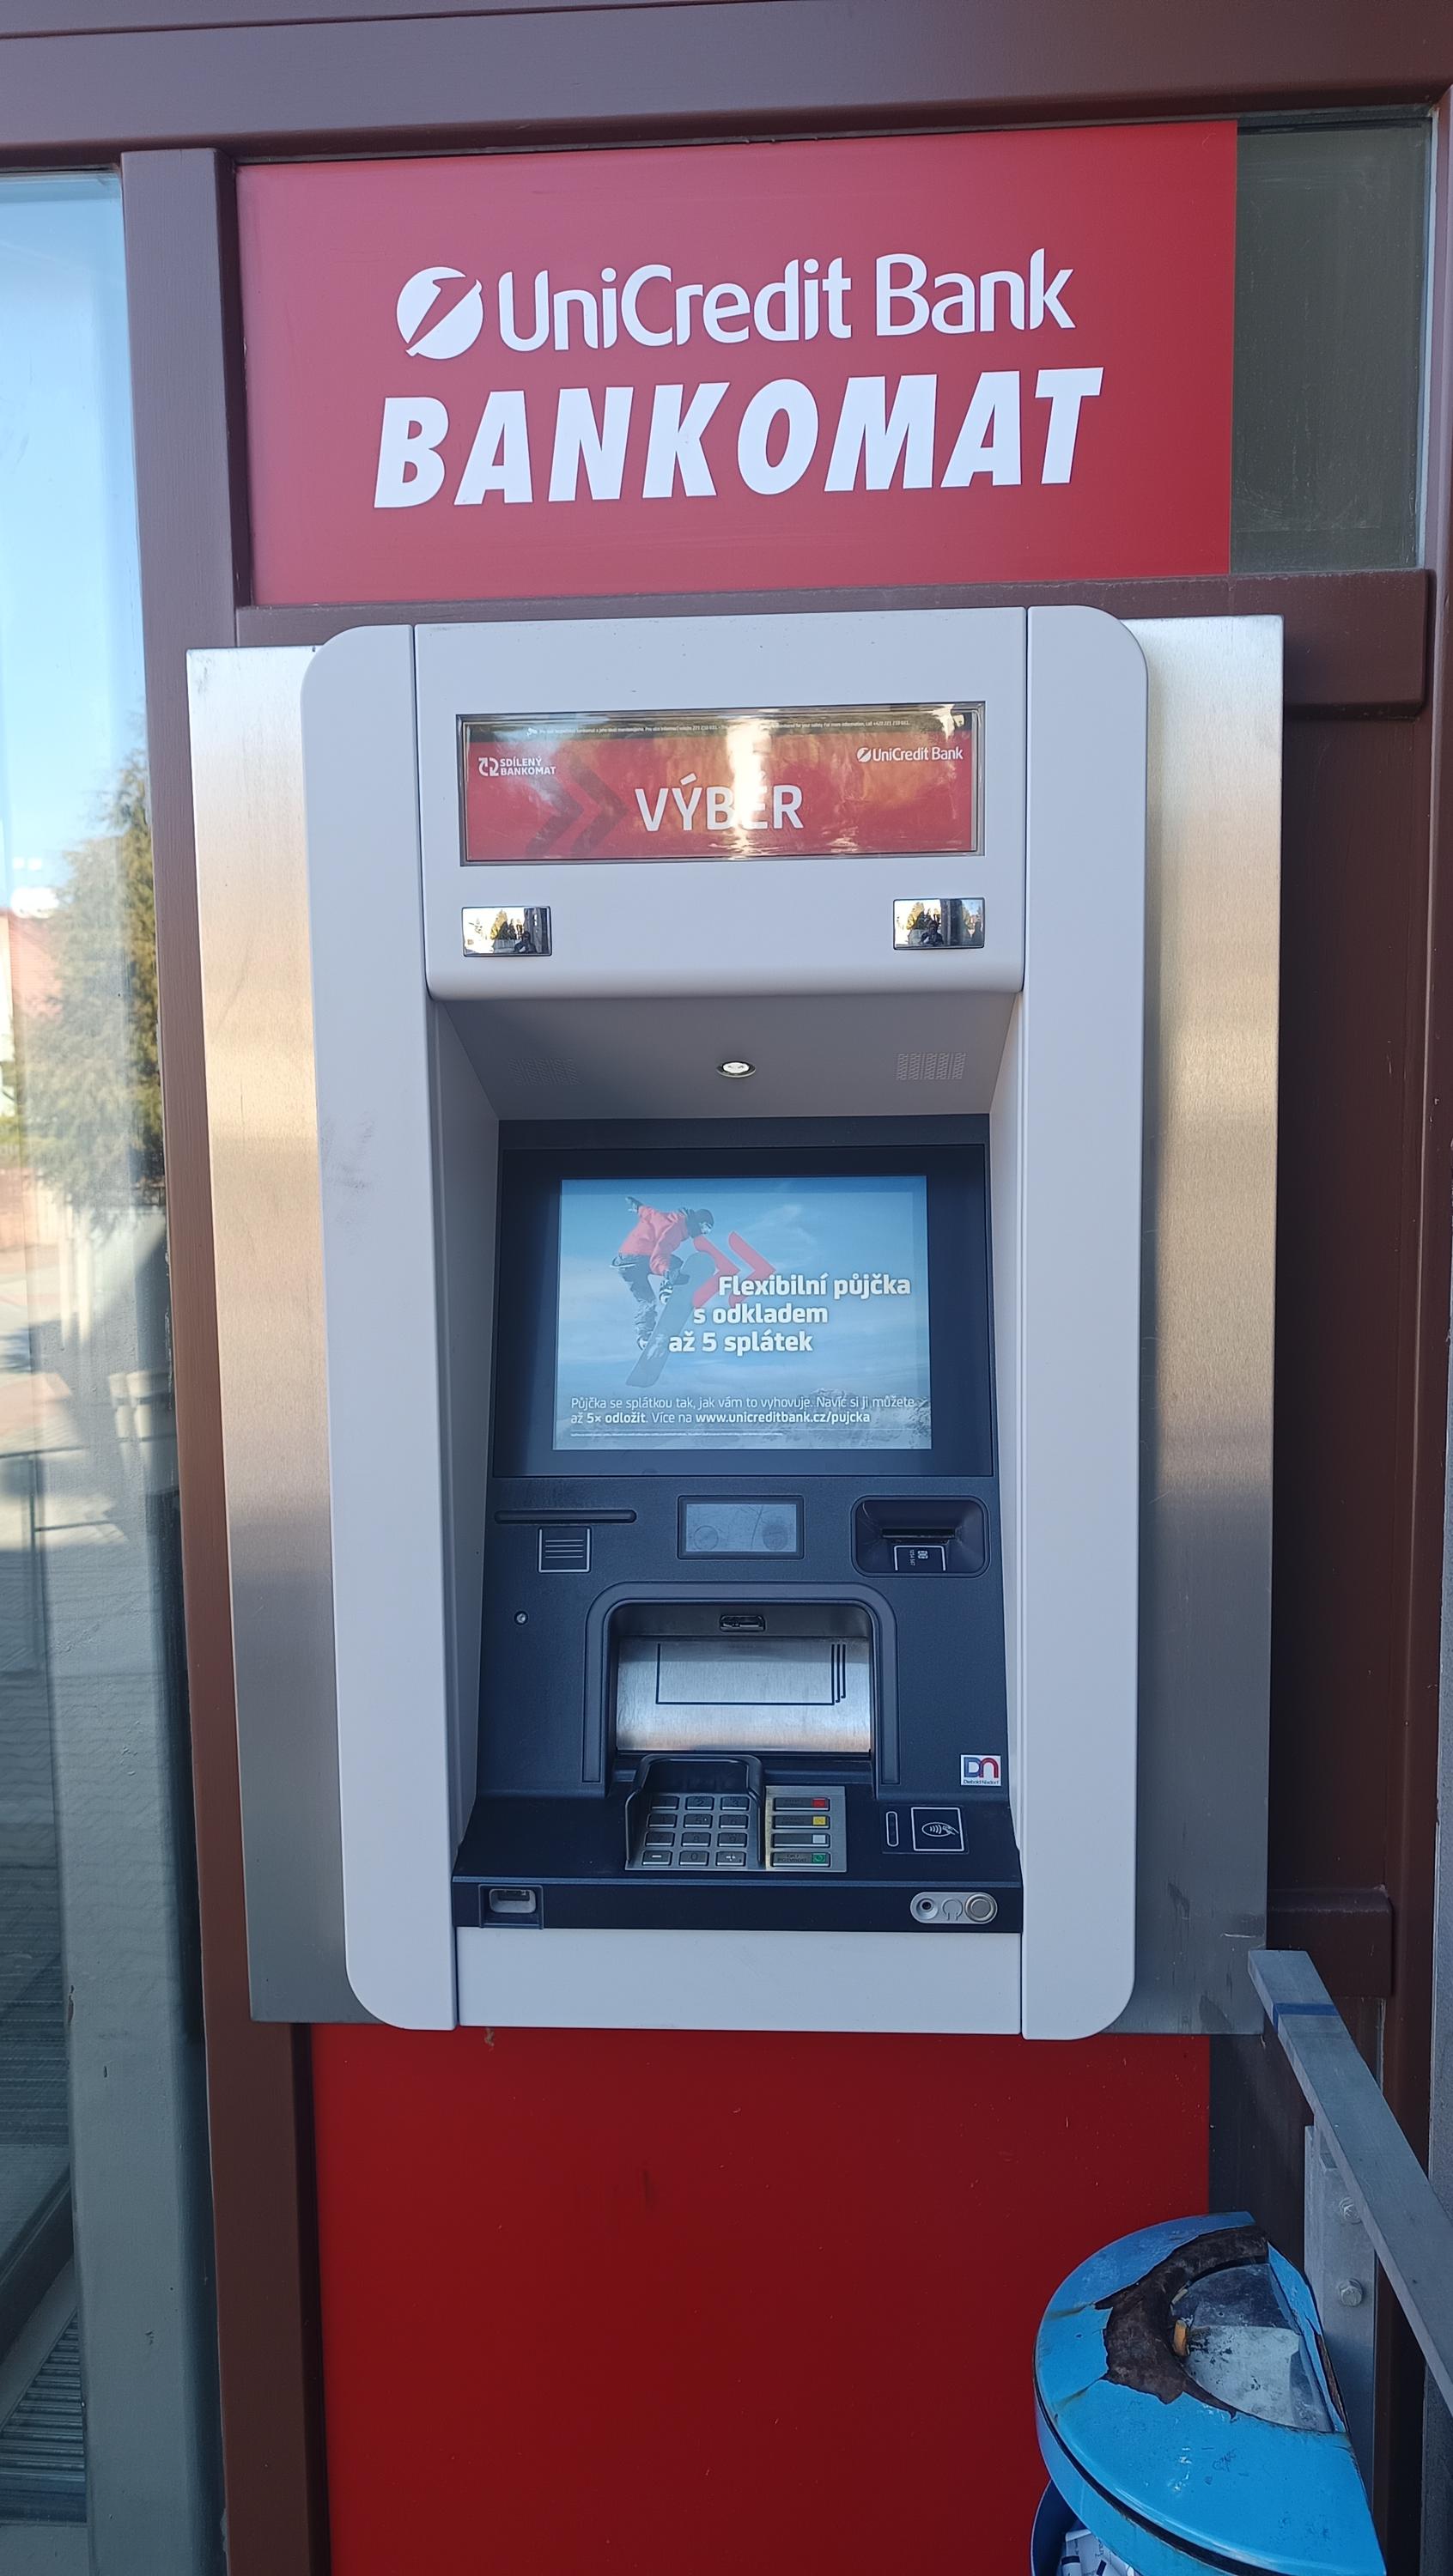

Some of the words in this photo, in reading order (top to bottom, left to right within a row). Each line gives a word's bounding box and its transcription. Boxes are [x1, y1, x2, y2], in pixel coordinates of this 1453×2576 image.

[498, 256, 853, 353] UniCredit
[876, 247, 1075, 337] Bank
[373, 367, 1105, 510] BANKOMAT
[500, 756, 542, 767] SDÍLENÝ
[872, 746, 929, 762] UniCredit
[931, 745, 964, 761] Bank
[500, 766, 556, 775] BANKOMAT
[718, 1273, 830, 1296] Flexibilní
[834, 1273, 911, 1299] půjčka
[693, 1307, 706, 1324] s
[712, 1303, 829, 1324] odkladem
[668, 1332, 695, 1352] až
[702, 1332, 717, 1352] 5
[724, 1328, 813, 1356] splátek
[571, 1397, 606, 1411] Půjčka
[610, 1400, 623, 1409] se
[625, 1397, 672, 1411] splátkou
[676, 1397, 696, 1410] tak,
[697, 1397, 714, 1411] jak
[718, 1396, 743, 1408] vám
[746, 1398, 757, 1408] to
[761, 1396, 812, 1411] vyhovuje.
[816, 1395, 847, 1408] Navíc
[850, 1397, 859, 1408] si
[861, 1397, 869, 1410] ji
[872, 1395, 915, 1408] můžete
[570, 1412, 583, 1424] až
[605, 1412, 648, 1424] odložit.
[651, 1412, 674, 1424] Více
[678, 1414, 692, 1423] na
[696, 1411, 870, 1425] www.unicreditbank.cz/pujcka
